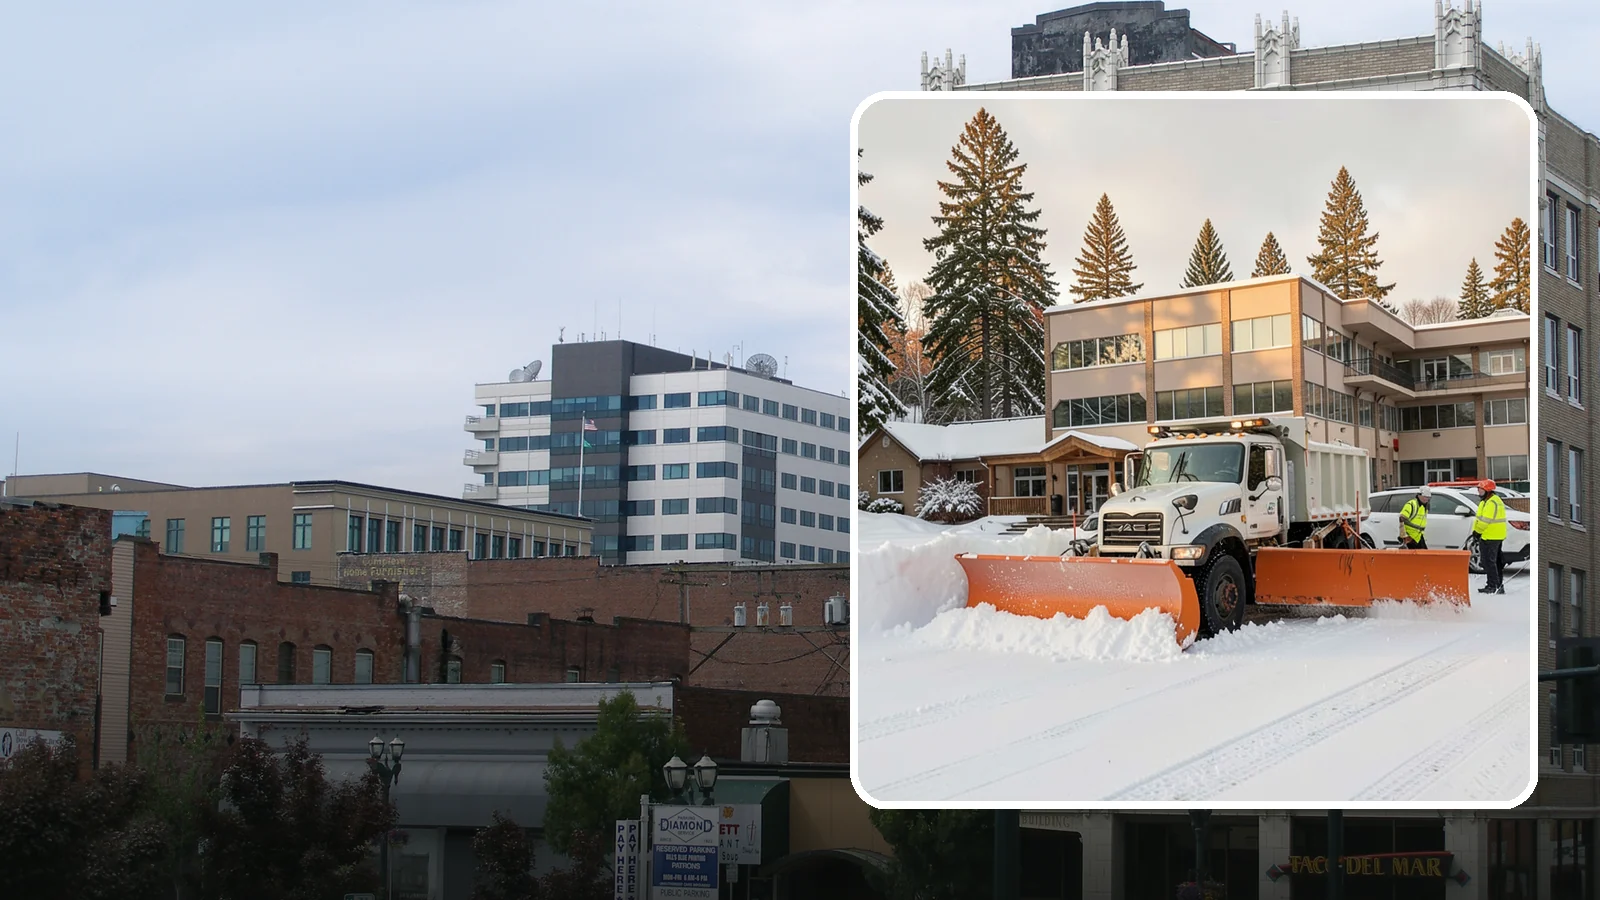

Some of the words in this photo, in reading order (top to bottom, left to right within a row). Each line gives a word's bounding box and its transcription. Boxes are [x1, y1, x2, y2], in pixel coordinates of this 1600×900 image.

[370, 566, 427, 577] Furnishers
[660, 818, 713, 832] DIAMOND
[1021, 815, 1070, 828] BUILDING
[628, 825, 636, 851] PAY
[689, 846, 716, 854] PARKING
[721, 851, 739, 861] Soup
[671, 862, 701, 870] PATRONS
[1288, 855, 1330, 874] TAC
[1346, 857, 1385, 875] DEL
[1392, 857, 1442, 877] MAR
[617, 856, 625, 894] HERE
[628, 856, 636, 893] HERE
[660, 888, 682, 897] PUBLIC
[683, 889, 710, 898] PARKING
